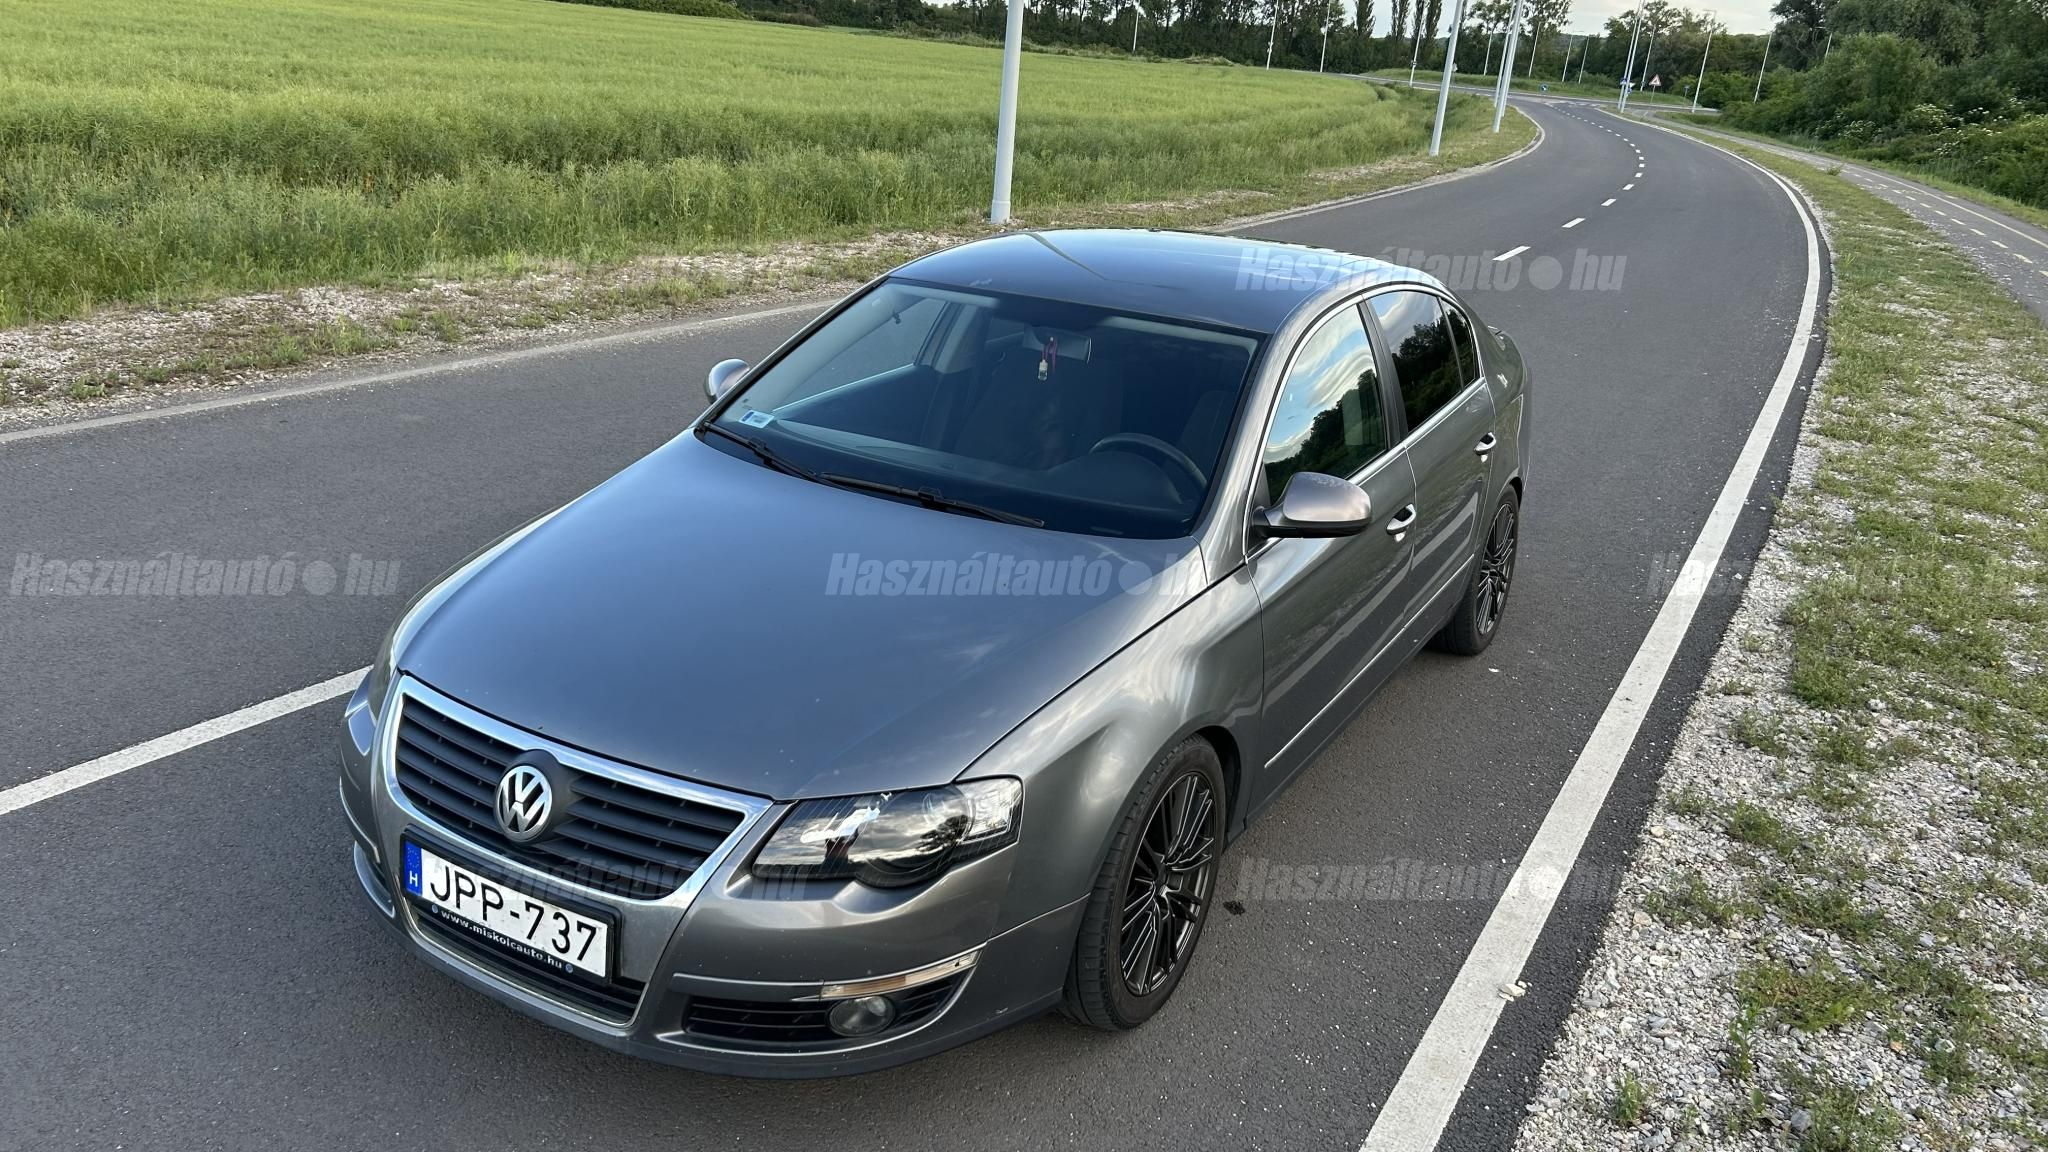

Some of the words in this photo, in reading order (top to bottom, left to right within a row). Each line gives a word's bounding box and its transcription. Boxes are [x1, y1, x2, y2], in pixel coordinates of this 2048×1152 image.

[408, 871, 418, 888] H
[430, 865, 597, 961] JPP-737
[441, 910, 563, 969] www.miskolcauto.hu
